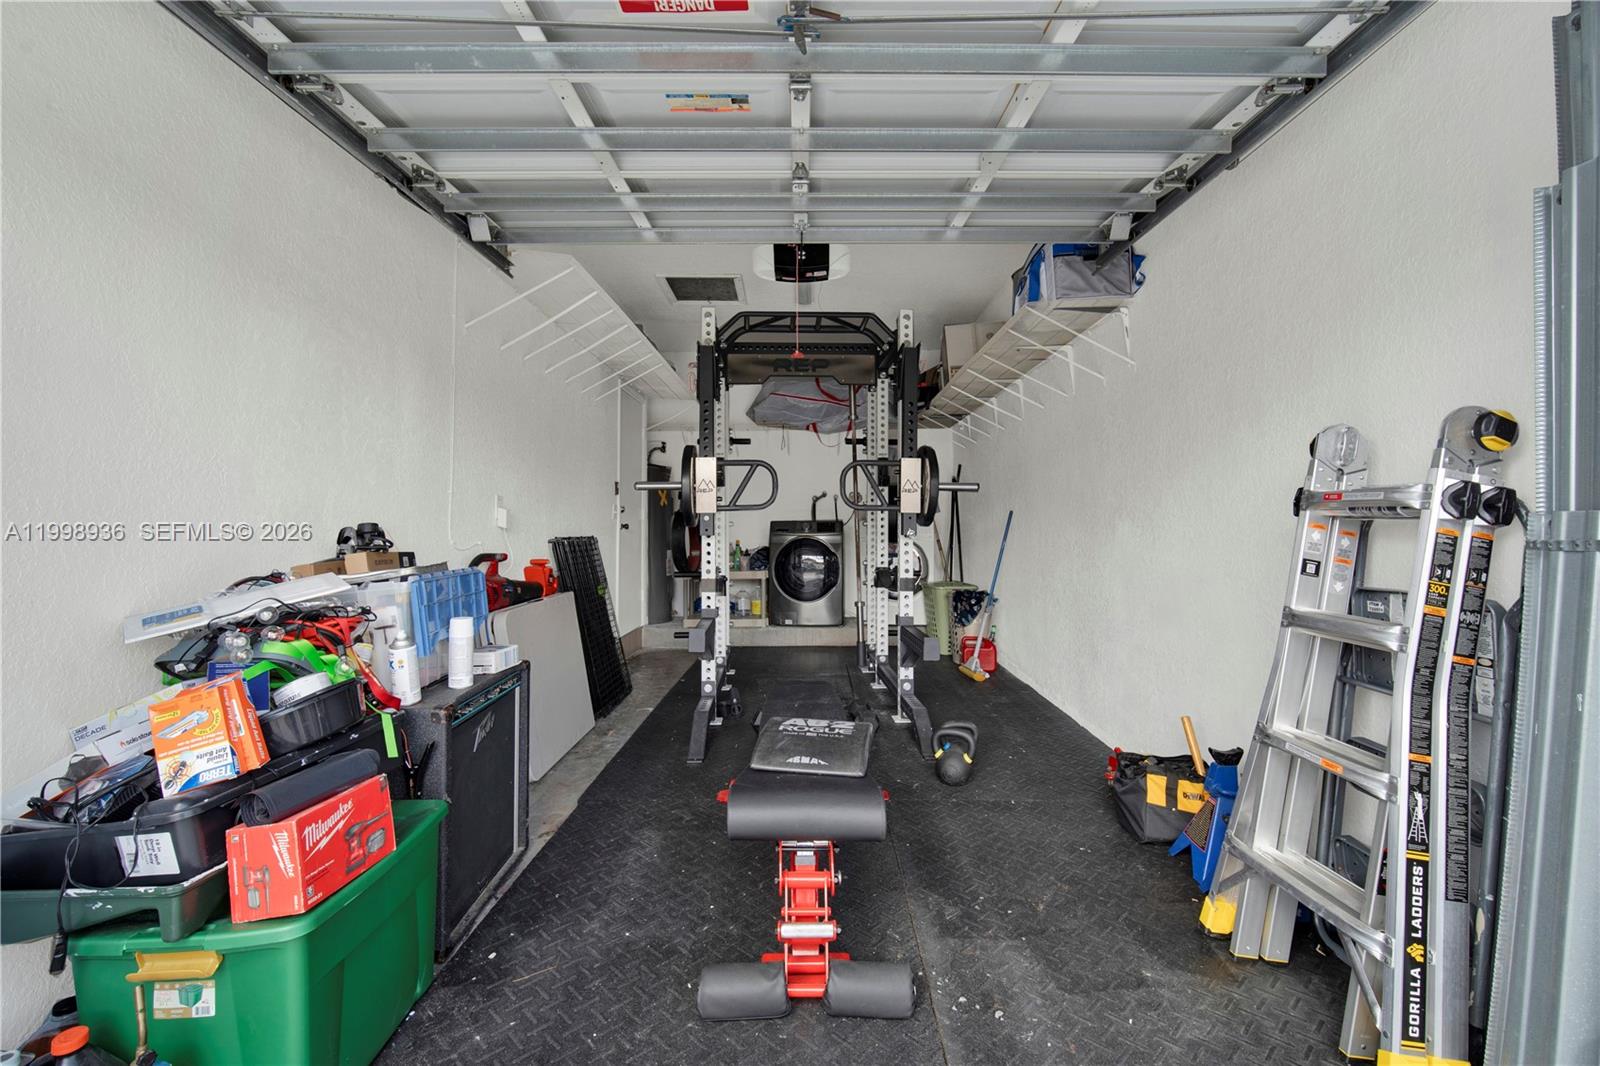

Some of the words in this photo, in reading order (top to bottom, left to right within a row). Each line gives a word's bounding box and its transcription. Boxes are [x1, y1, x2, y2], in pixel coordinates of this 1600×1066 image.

[654, 0, 716, 12] DANGER!
[773, 359, 831, 372] REP
[1429, 583, 1446, 595] 300
[74, 725, 107, 741] DECADE
[779, 726, 852, 734] ROGUE
[199, 765, 232, 783] TERRO
[302, 799, 353, 851] Milwaukee
[274, 830, 295, 878] Milwaukee
[1411, 865, 1424, 938] LADDERS
[1409, 967, 1421, 1038] GORILLA
